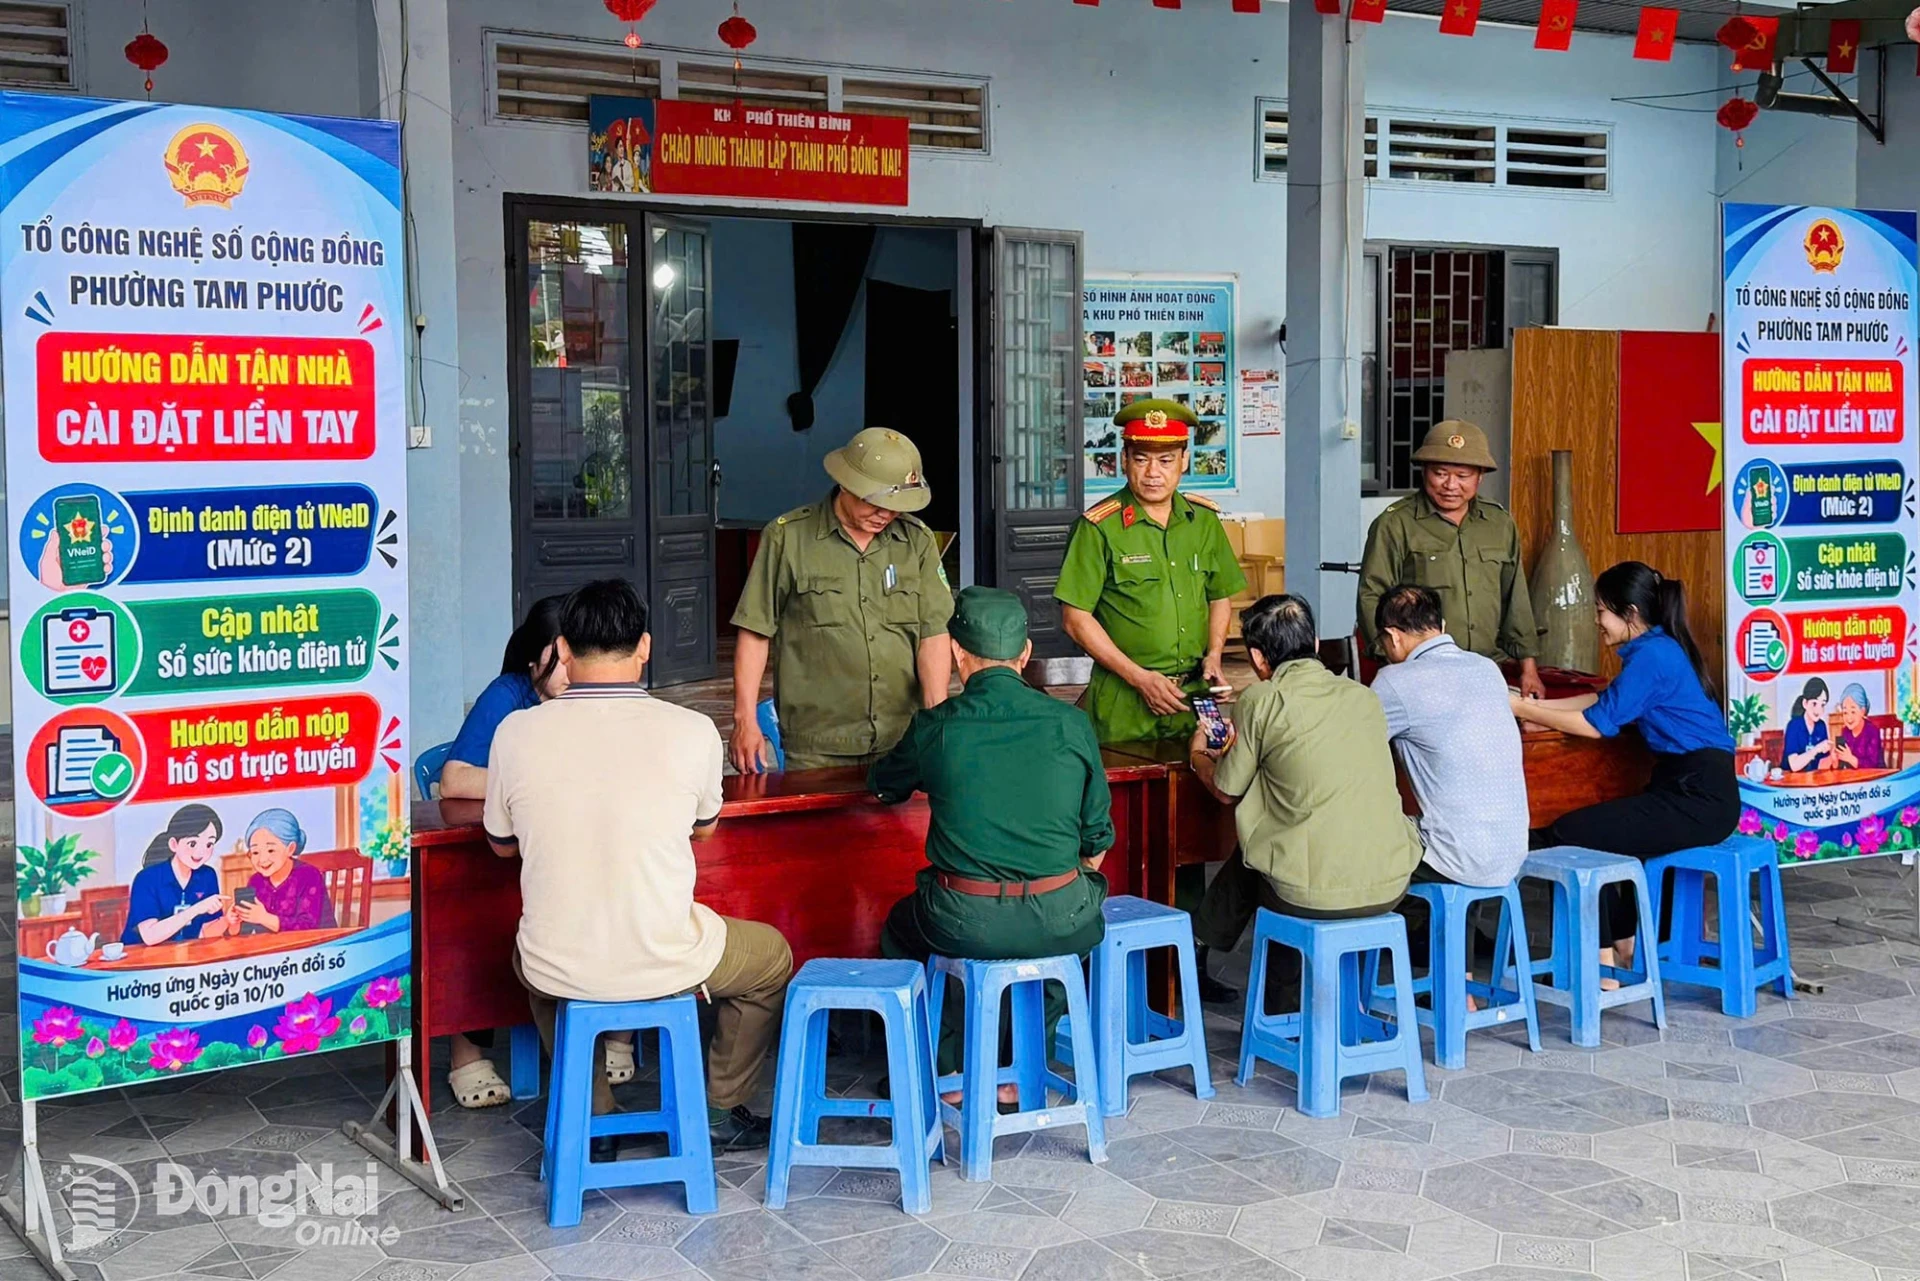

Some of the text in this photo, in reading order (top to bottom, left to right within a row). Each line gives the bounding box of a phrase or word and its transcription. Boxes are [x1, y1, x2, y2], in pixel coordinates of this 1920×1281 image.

[714, 108, 851, 131] KH PHỐ THIÊN BÌNH
[661, 126, 901, 176] CHÀO MỪNG THÀNH LẬP THÀNH PHỐ ĐỒNG NAI!
[21, 215, 383, 267] TỔ CÔNG NGHỆ SỐ CỘNG ĐỒNG
[70, 270, 343, 313] PHƯỜNG TAM PHƯỚC
[1083, 288, 1215, 305] SỐ HÌNH ẢNH HOẠT ĐỘNG
[1736, 282, 1908, 313] TỔ CÔNG NGHỆ SỐ CỘNG ĐỒNG
[1093, 310, 1115, 320] KHU
[1119, 307, 1140, 320] PHỐ
[1144, 308, 1174, 320] THIÊN
[1179, 308, 1203, 320] BÌNH
[1758, 317, 1888, 342] PHƯỜNG TAM PHƯỚC
[62, 341, 352, 391] HƯỚNG DẪN TẬN NHÀ
[1753, 364, 1893, 396] HƯỚNG DẪN TẬN NHÀ
[56, 398, 358, 453] CÀI ĐẶT LIỀN TAY
[1750, 402, 1896, 438] CÀI ĐẶT LIỀN TAY
[1793, 471, 1901, 496] Định danh điện tử VNeID
[149, 501, 369, 539] Định danh điện tử VNeID
[1821, 496, 1873, 518] (Mức 2)
[207, 536, 311, 570] (Mức 2)
[1818, 544, 1876, 568] Cập nhật
[1797, 565, 1899, 591] Sổ sức khỏe điện tử
[201, 604, 319, 643] Cập nhật
[1803, 613, 1891, 638] Hướng dẫn nộp
[158, 636, 366, 678] Sổ sức khỏe điện tử
[1802, 636, 1895, 664] hồ sơ trực tuyến
[170, 707, 349, 748] Hướng dẫn nộp
[168, 737, 356, 784] hồ sơ trực tuyến
[1804, 804, 1860, 821] quốc gia 10/10
[107, 951, 346, 1001] Hưởng ứng Ngày Chuyển đổi số
[169, 982, 284, 1016] quốc gia 10/10
